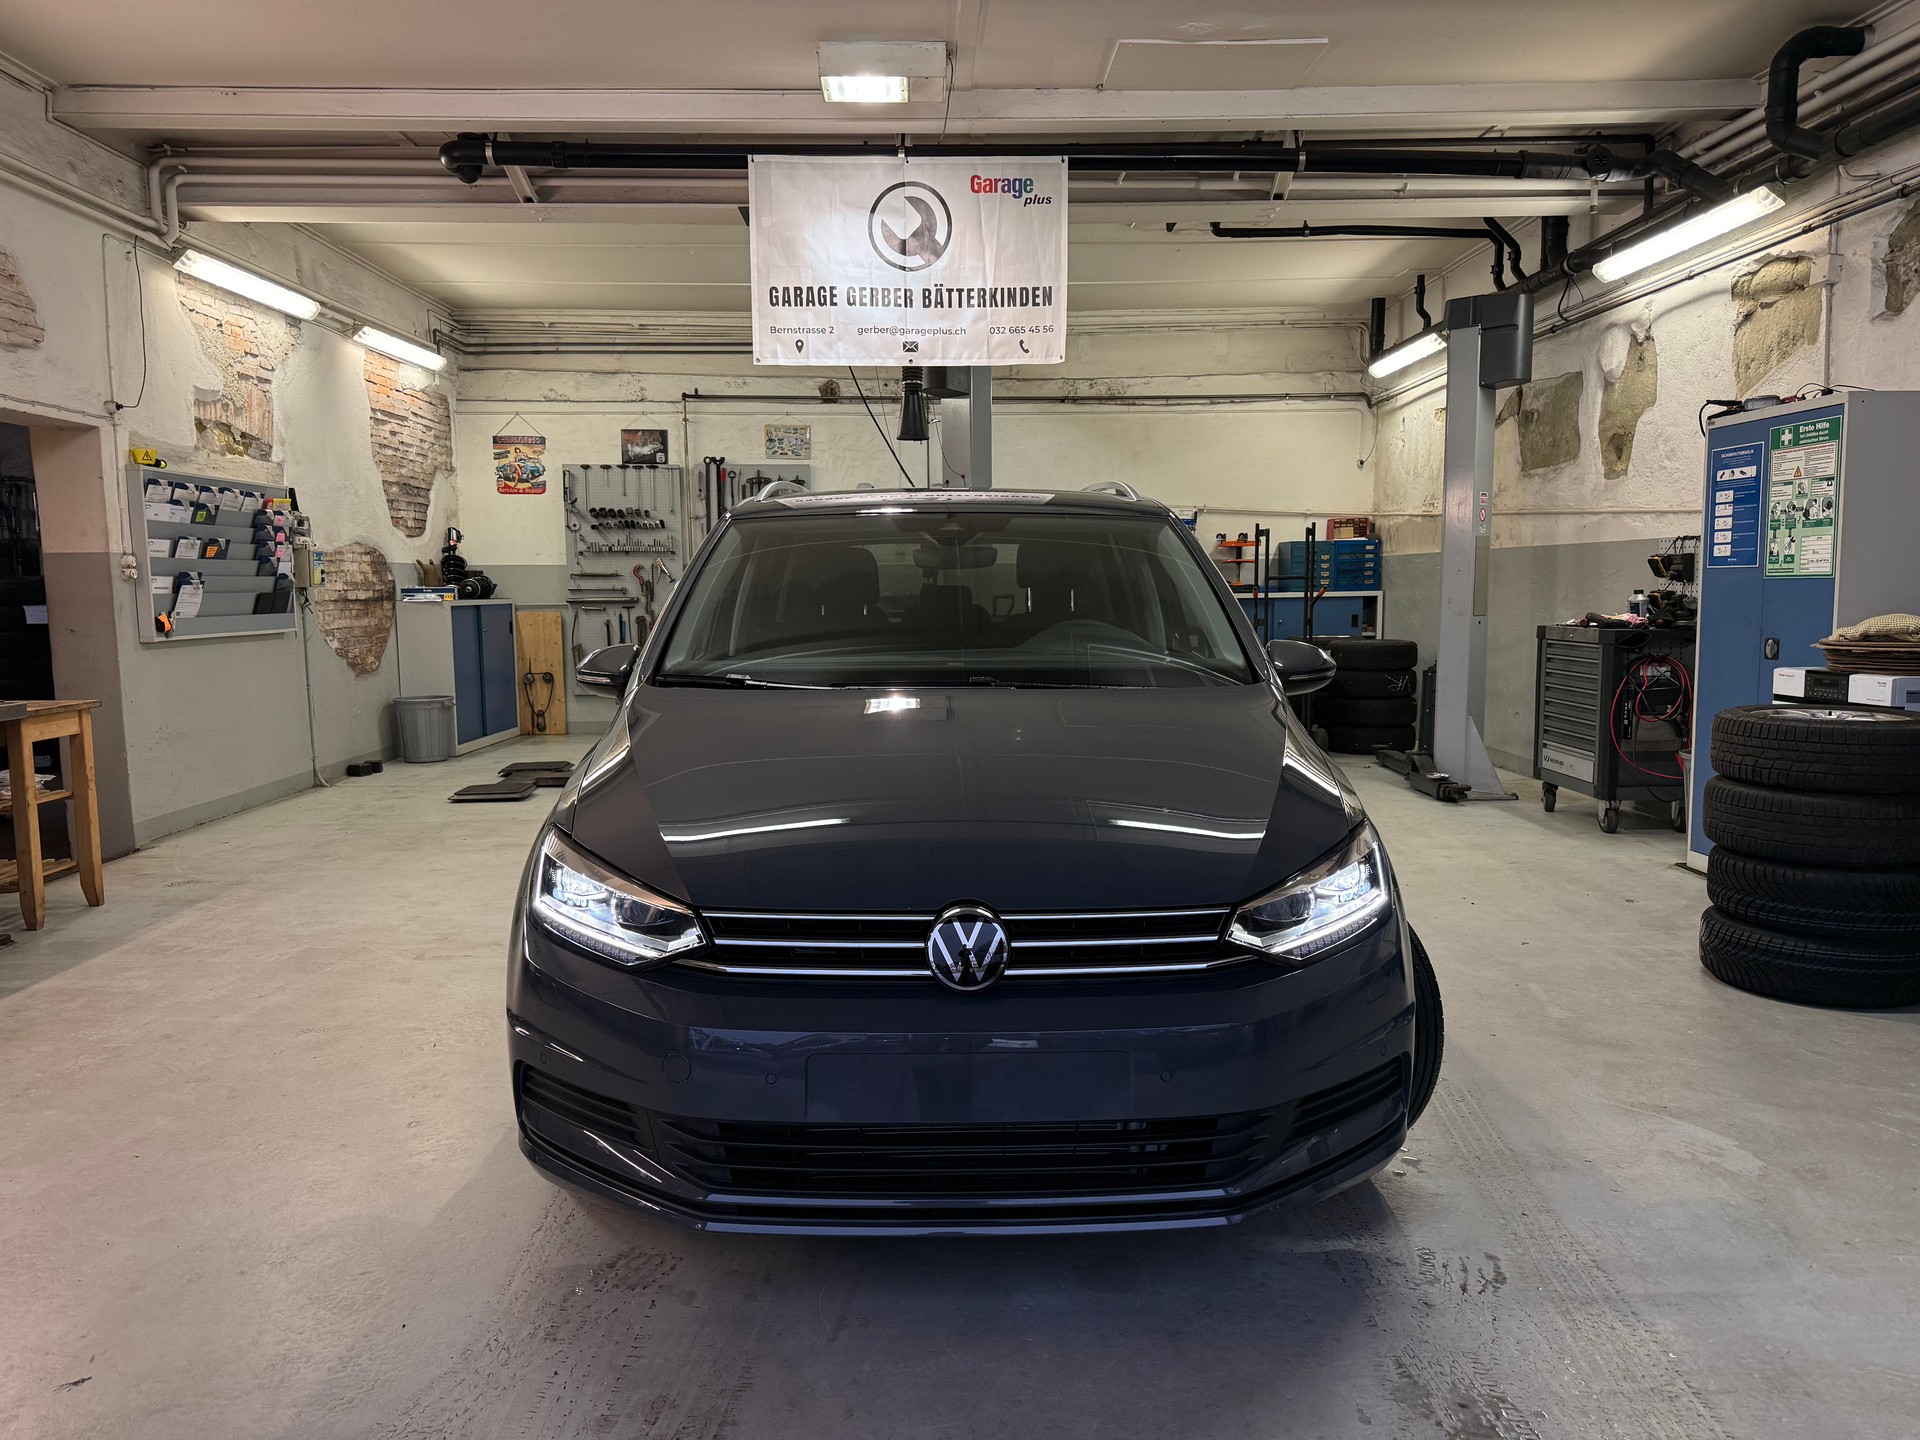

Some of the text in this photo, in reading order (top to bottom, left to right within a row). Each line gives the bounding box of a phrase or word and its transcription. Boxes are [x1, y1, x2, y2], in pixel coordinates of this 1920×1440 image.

[970, 174, 1034, 199] Garage
[1023, 194, 1053, 207] plus
[769, 283, 1053, 309] GARAGE GERBER BÄTTERKINDEN
[769, 325, 835, 335] Bernstrasse 2
[857, 325, 967, 336] gerber@garageplus.ch
[989, 324, 1055, 335] 032 665 45 56
[1816, 422, 1830, 430] Hilfe
